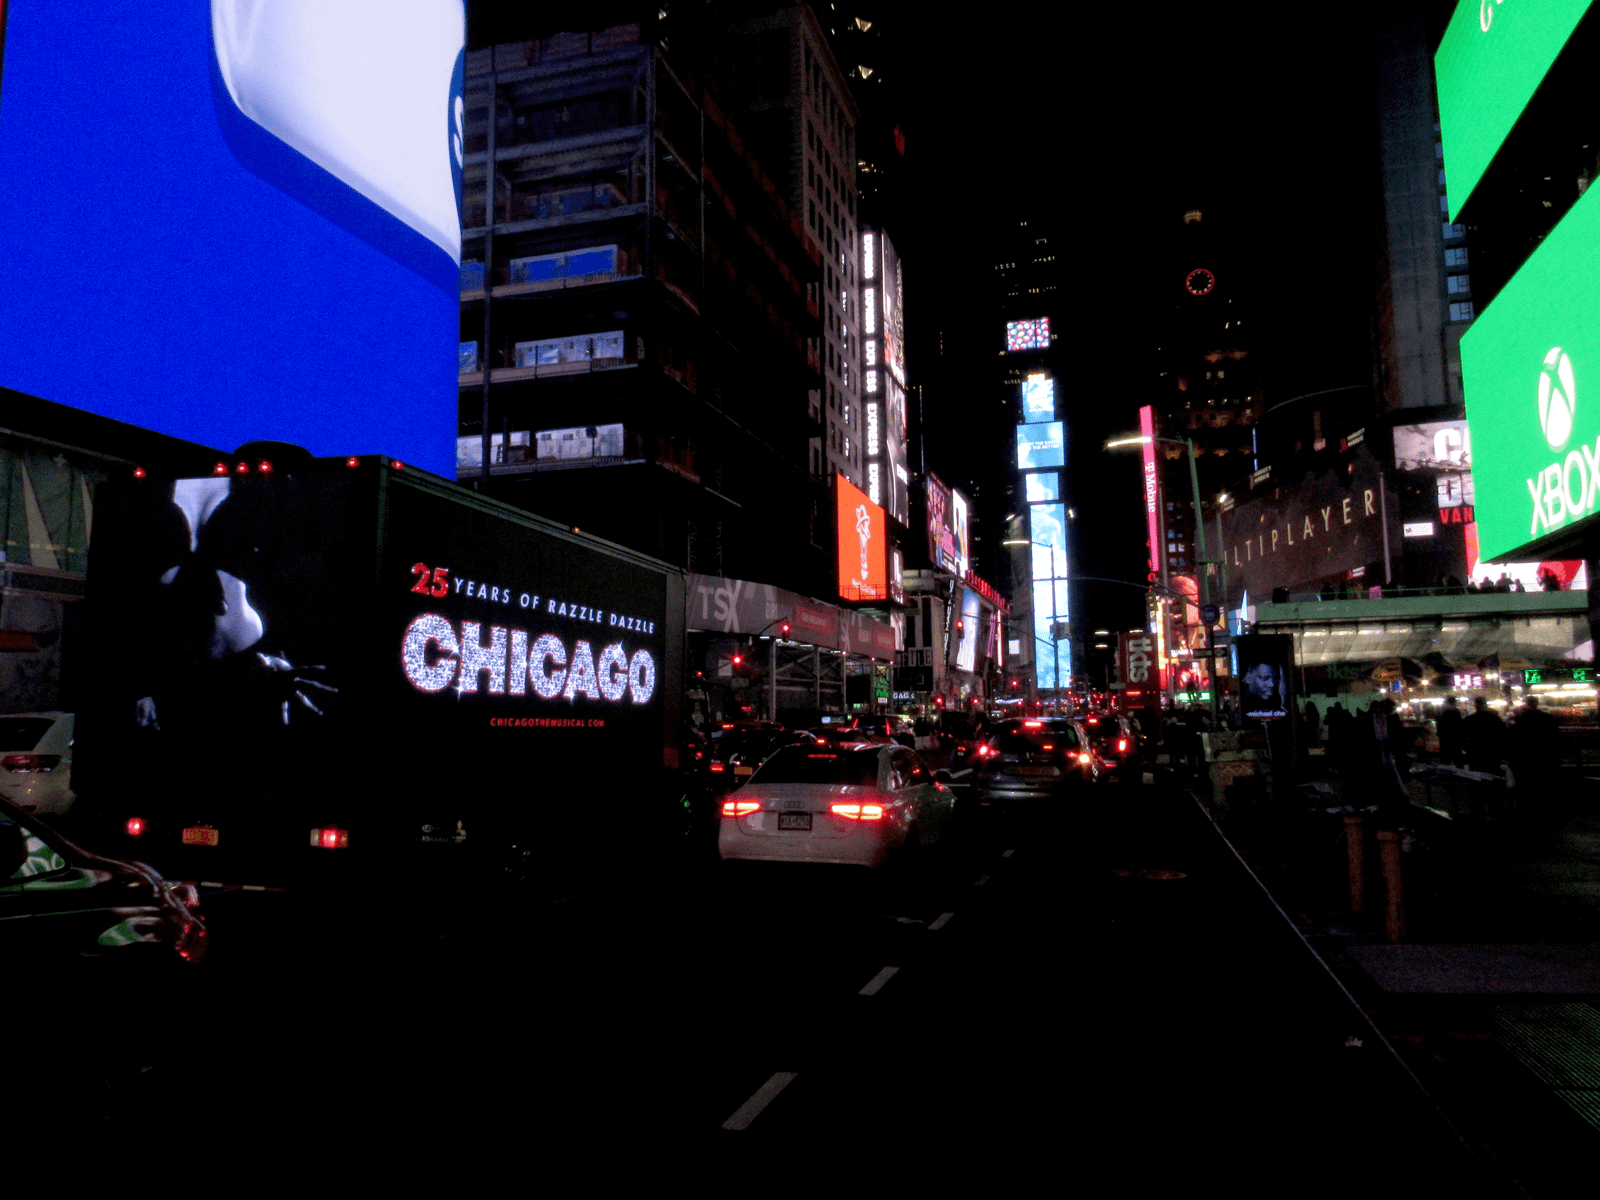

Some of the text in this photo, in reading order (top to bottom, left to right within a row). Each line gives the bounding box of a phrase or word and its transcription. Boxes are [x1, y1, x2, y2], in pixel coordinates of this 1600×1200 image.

[867, 403, 879, 456] EXPRESS
[1526, 436, 1600, 534] XBOX
[411, 562, 655, 635] 25 YEARS OF RAZZLE DAZZLE
[697, 579, 741, 632] TSX
[402, 613, 656, 704] CHICAGO
[490, 717, 605, 728] CHICAGOTHEMUSICAL.COM
